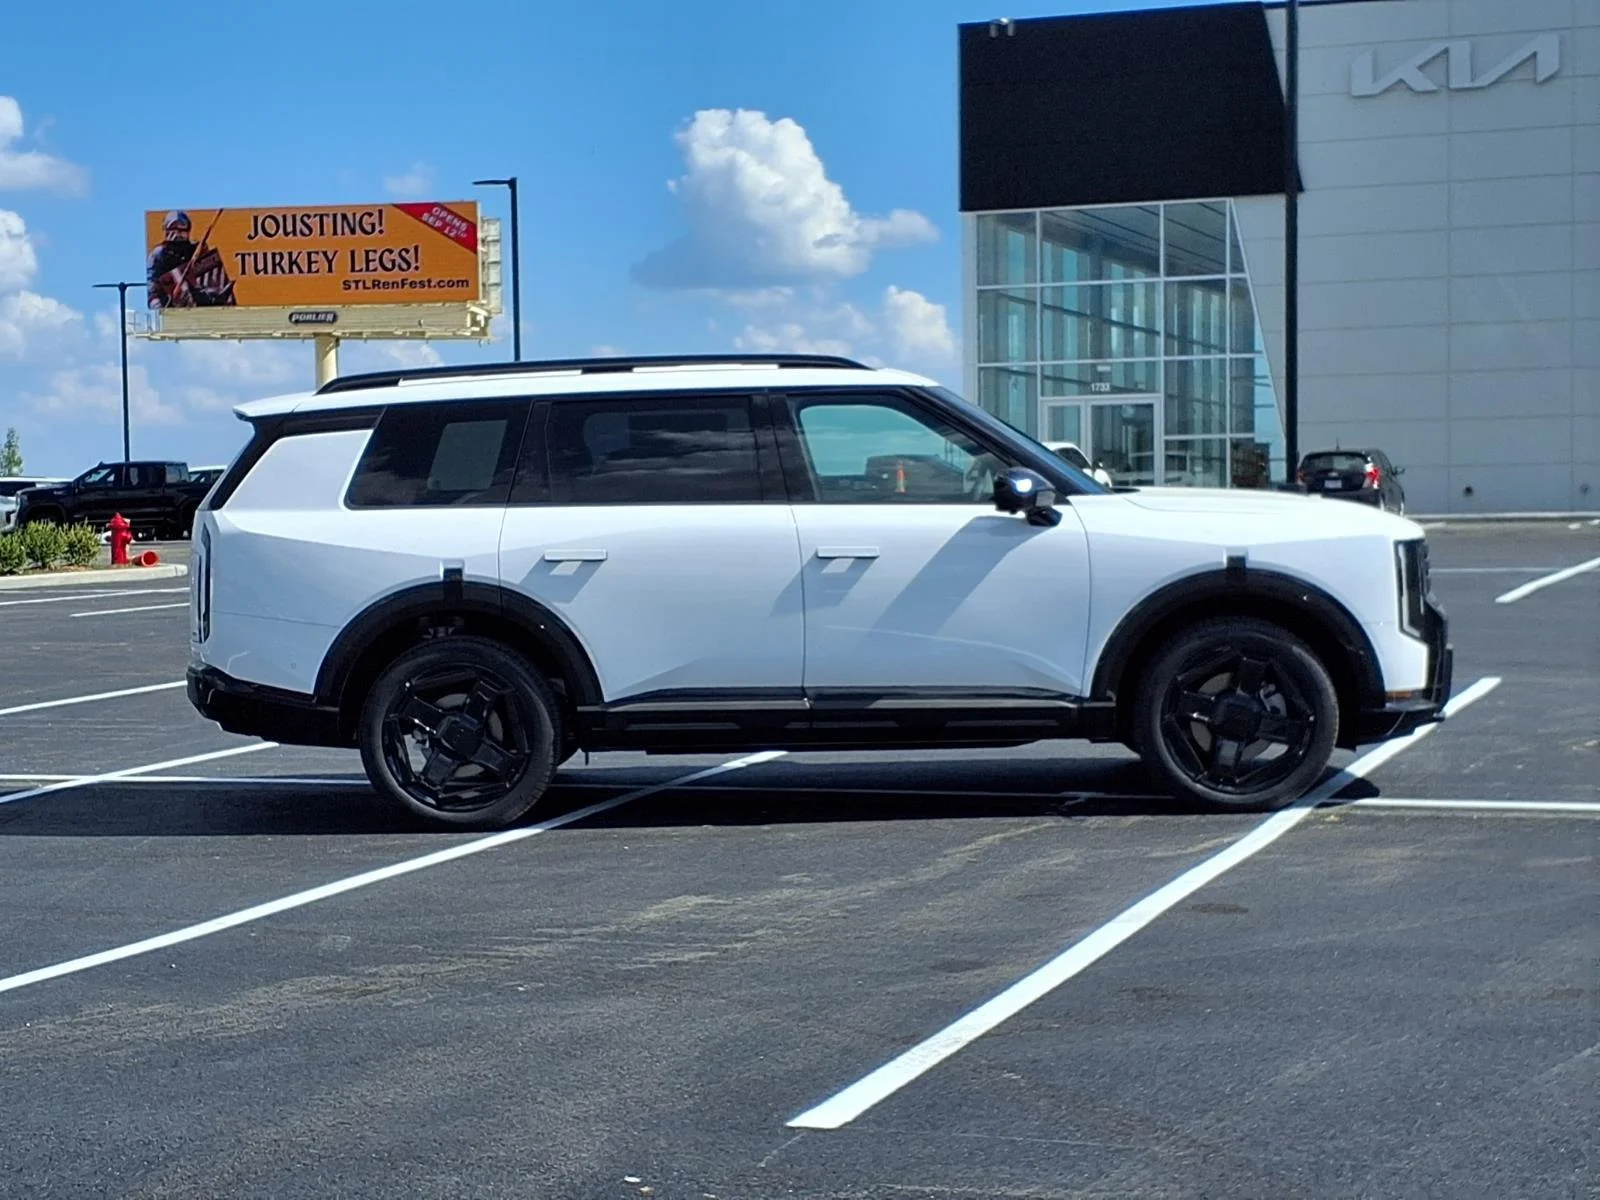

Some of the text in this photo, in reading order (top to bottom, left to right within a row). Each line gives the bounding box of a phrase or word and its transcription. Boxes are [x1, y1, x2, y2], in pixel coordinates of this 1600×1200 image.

[1351, 33, 1560, 98] KIA
[247, 209, 385, 240] JOUSTING!
[422, 212, 443, 228] SEP
[432, 206, 468, 232] OPENS
[235, 245, 420, 276] TURKEY LEGS!
[342, 278, 470, 291] STLRenFest.com
